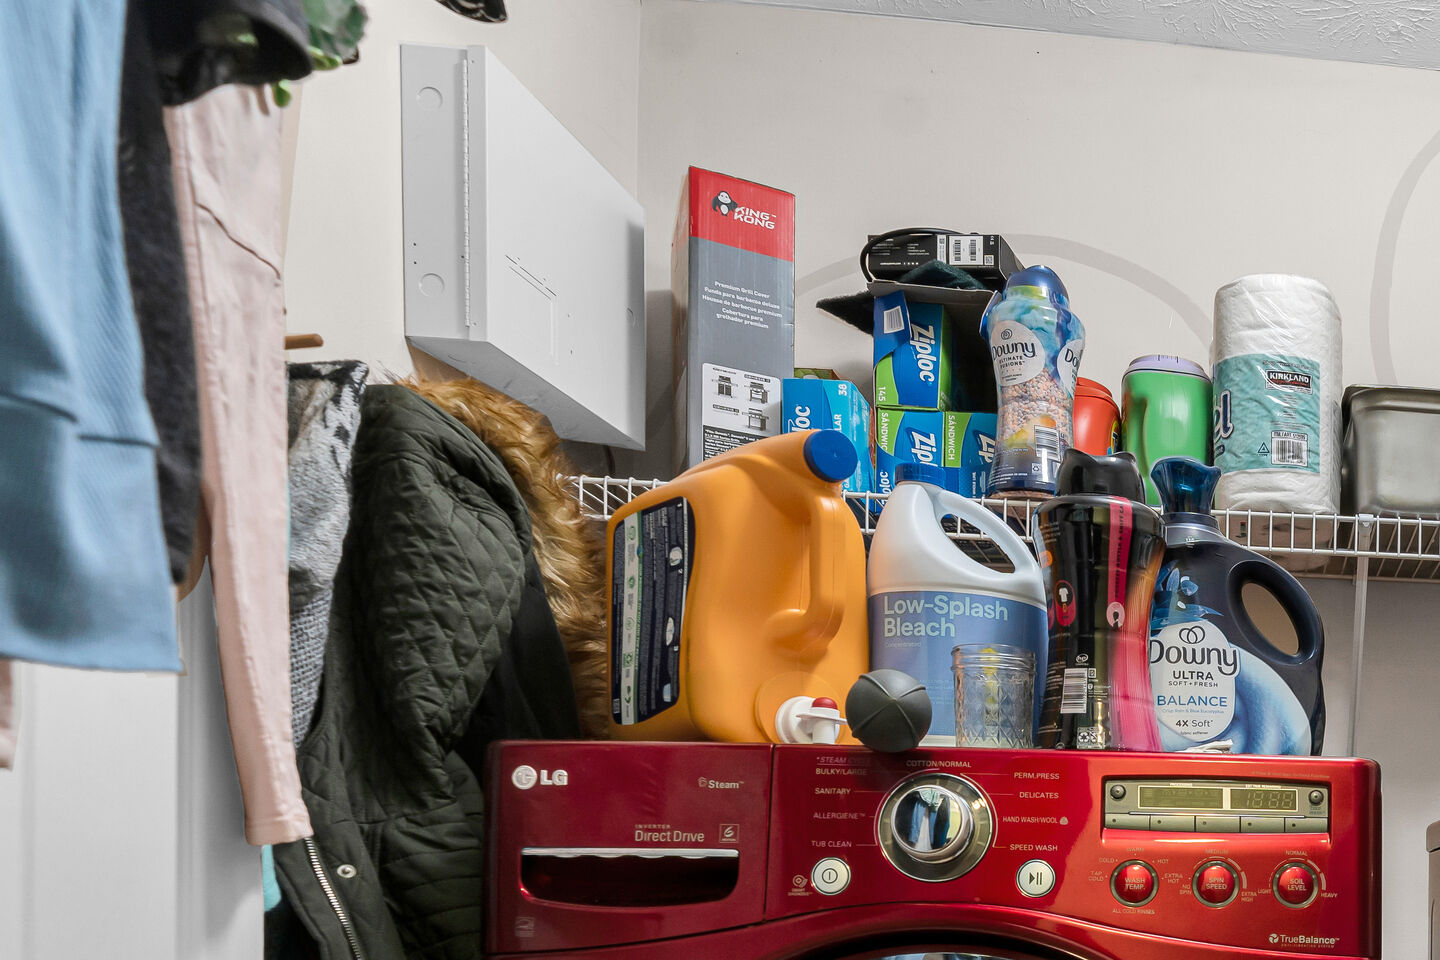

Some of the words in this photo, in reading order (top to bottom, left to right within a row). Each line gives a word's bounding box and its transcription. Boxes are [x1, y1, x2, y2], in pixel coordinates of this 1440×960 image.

[734, 212, 776, 230] KONG
[714, 281, 740, 291] Premium
[909, 323, 937, 383] Ziploc
[1269, 372, 1309, 384] KIRKLAND
[878, 387, 886, 401] 145
[884, 594, 1008, 621] Low-Splash
[884, 617, 955, 637] Bleach
[1150, 639, 1238, 676] Downy
[1172, 670, 1214, 680] ULTRA
[1157, 695, 1228, 707] BALANCE
[906, 760, 971, 768] COTTON/NORMAL
[539, 769, 568, 786] LG
[1019, 791, 1059, 799] DELICATES
[1020, 816, 1058, 824] WASH/WOOL
[634, 830, 671, 842] Direct
[673, 830, 705, 842] Drive
[1280, 934, 1336, 944] TrueBalance
